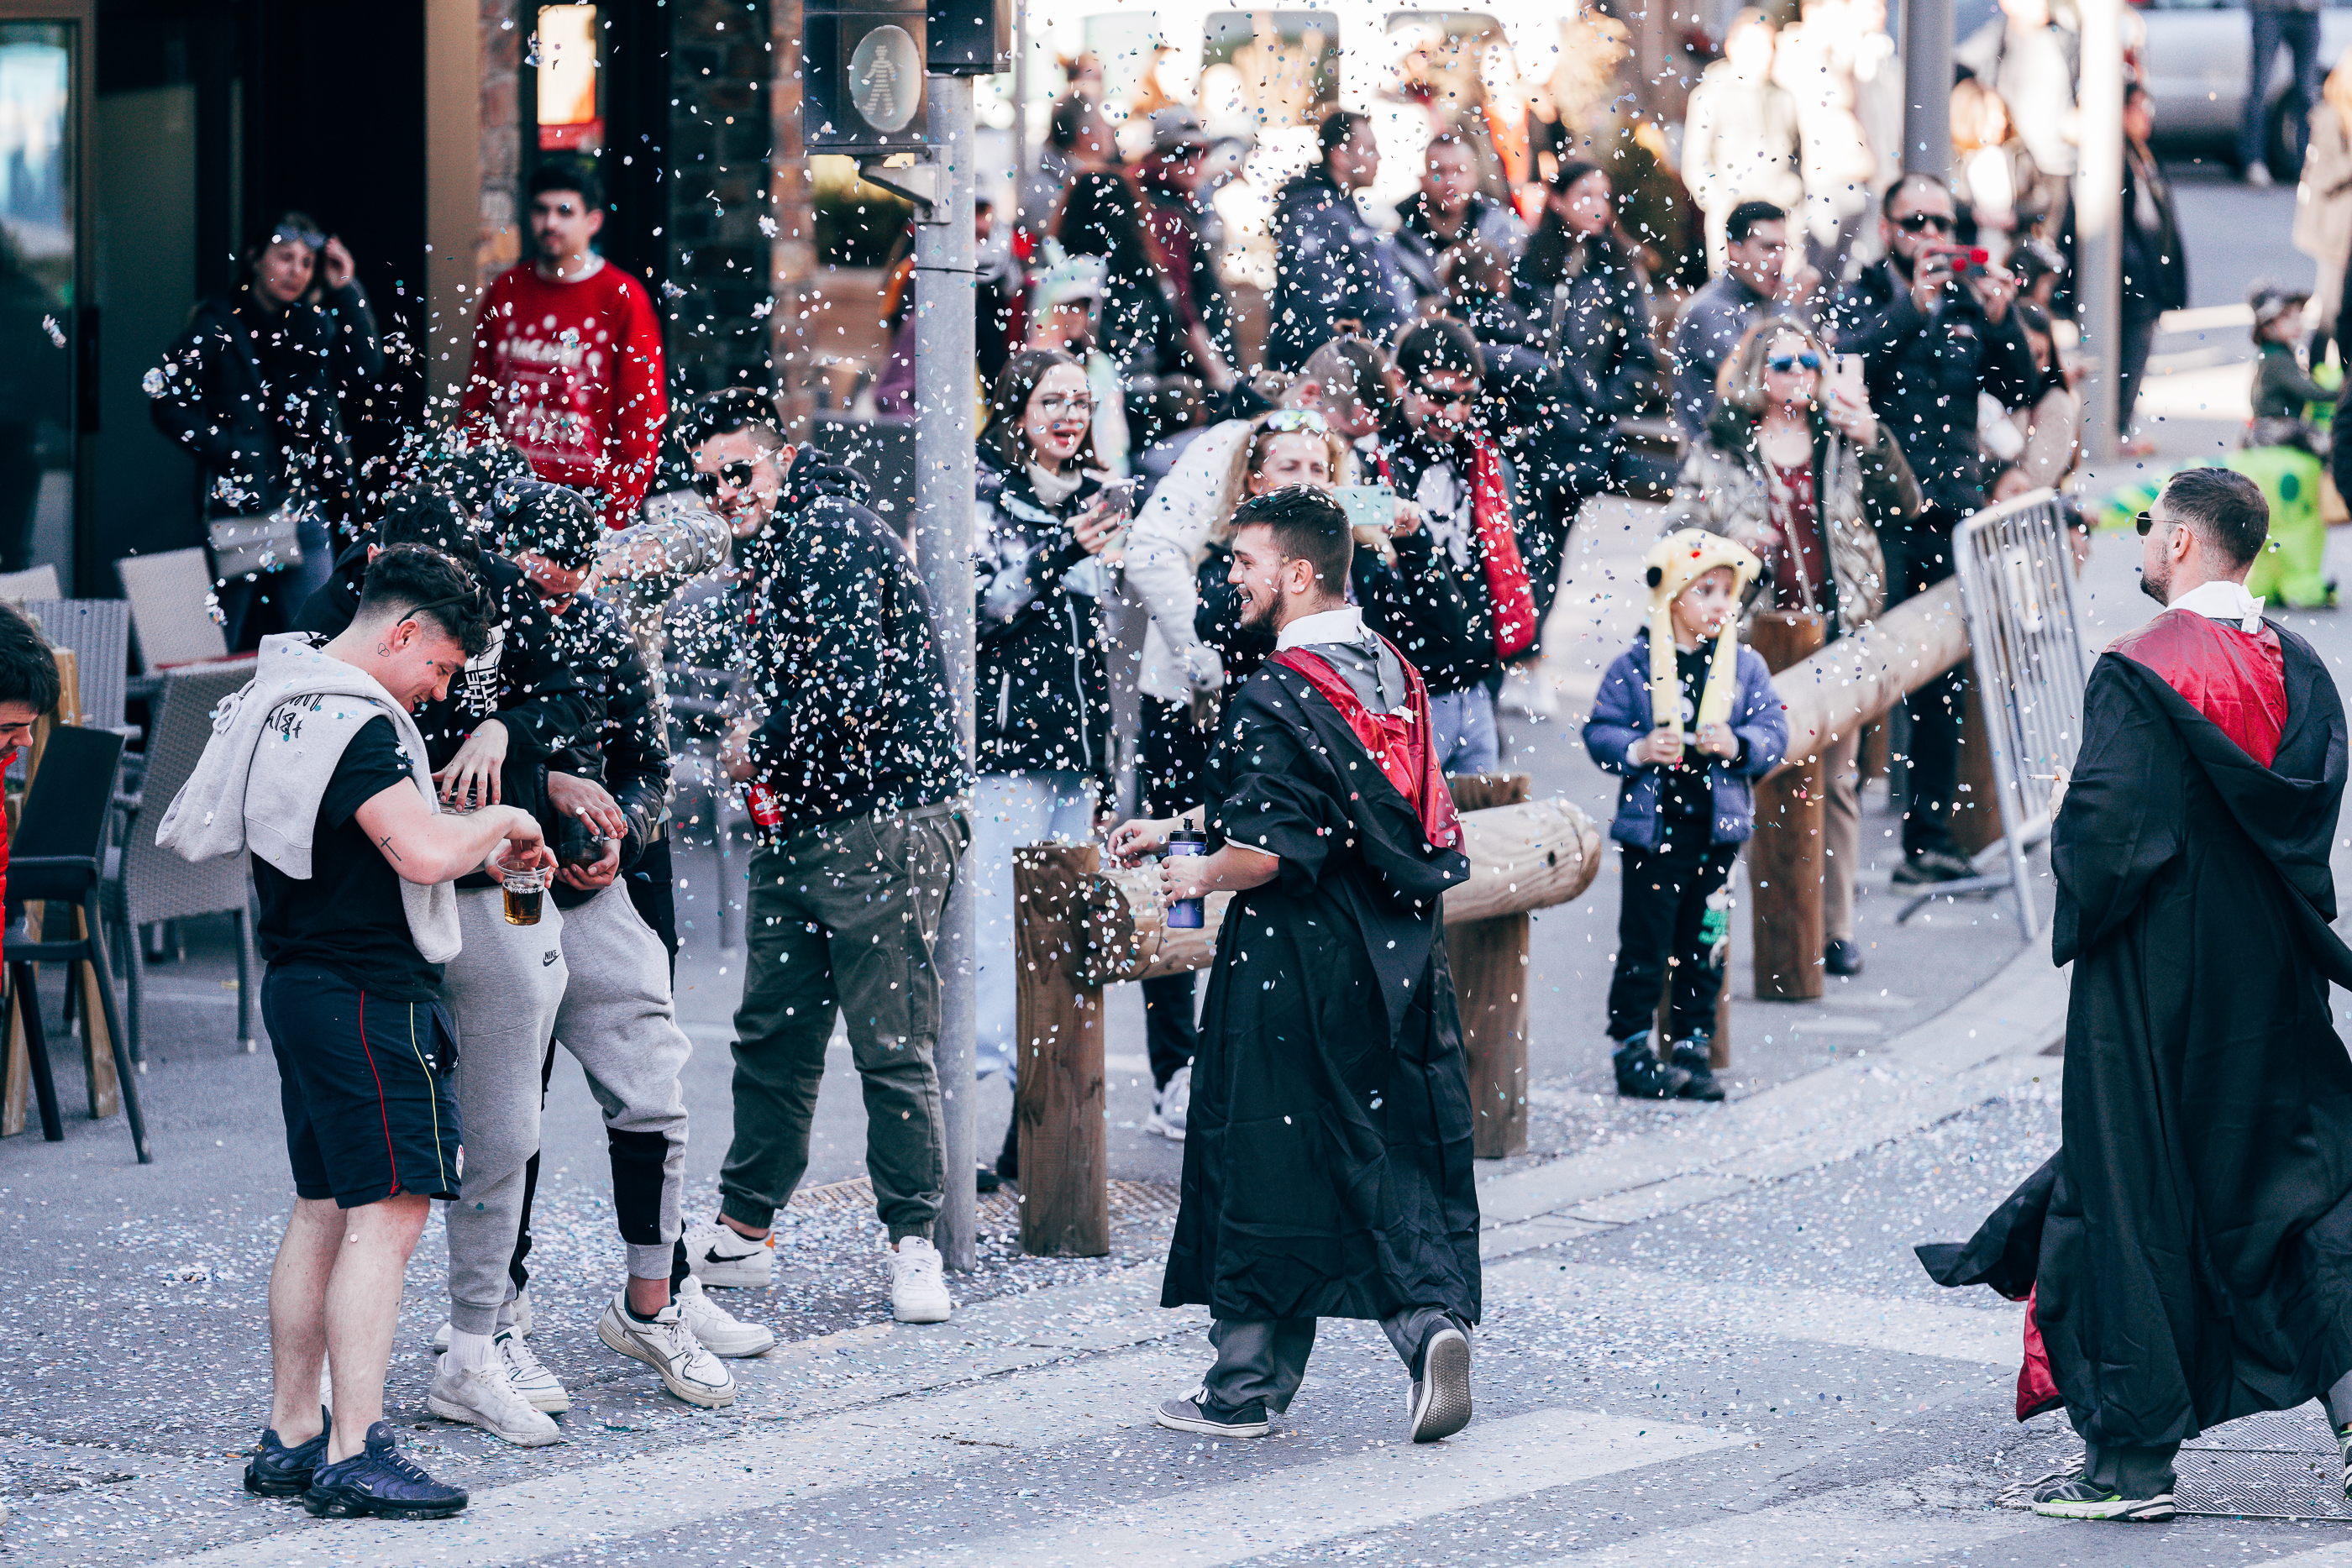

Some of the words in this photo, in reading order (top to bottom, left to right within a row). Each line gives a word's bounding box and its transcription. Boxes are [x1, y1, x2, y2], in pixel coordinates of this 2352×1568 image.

[465, 672, 485, 714] THE
[485, 668, 497, 718] RTH
[545, 949, 557, 960] NIKE
